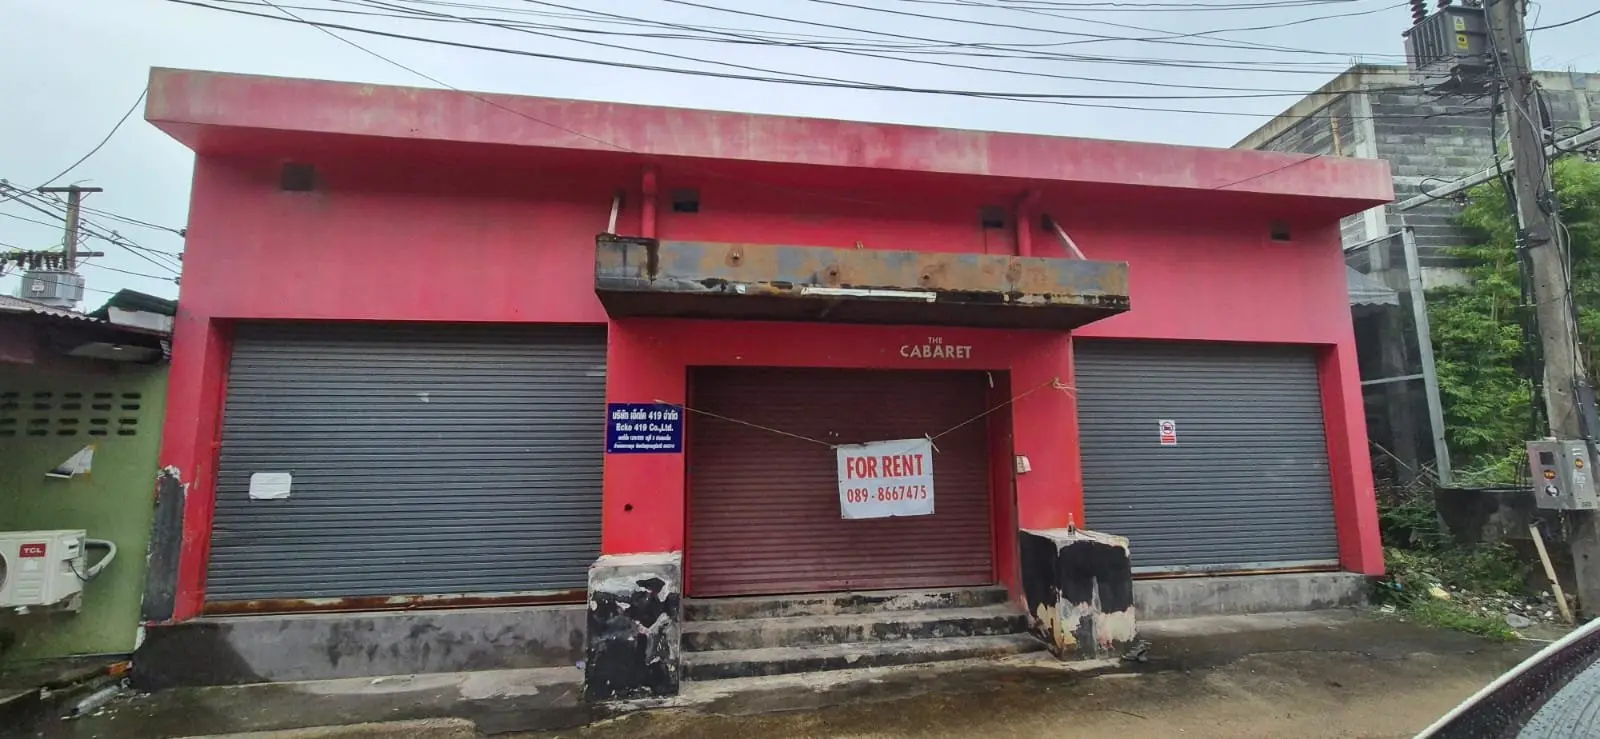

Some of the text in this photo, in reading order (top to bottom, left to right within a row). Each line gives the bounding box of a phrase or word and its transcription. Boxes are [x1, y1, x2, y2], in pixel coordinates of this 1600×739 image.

[900, 345, 972, 359] CABARET
[648, 411, 662, 420] 419
[616, 423, 632, 431] Ecko
[634, 423, 647, 431] 419
[846, 454, 924, 480] FOR RENT
